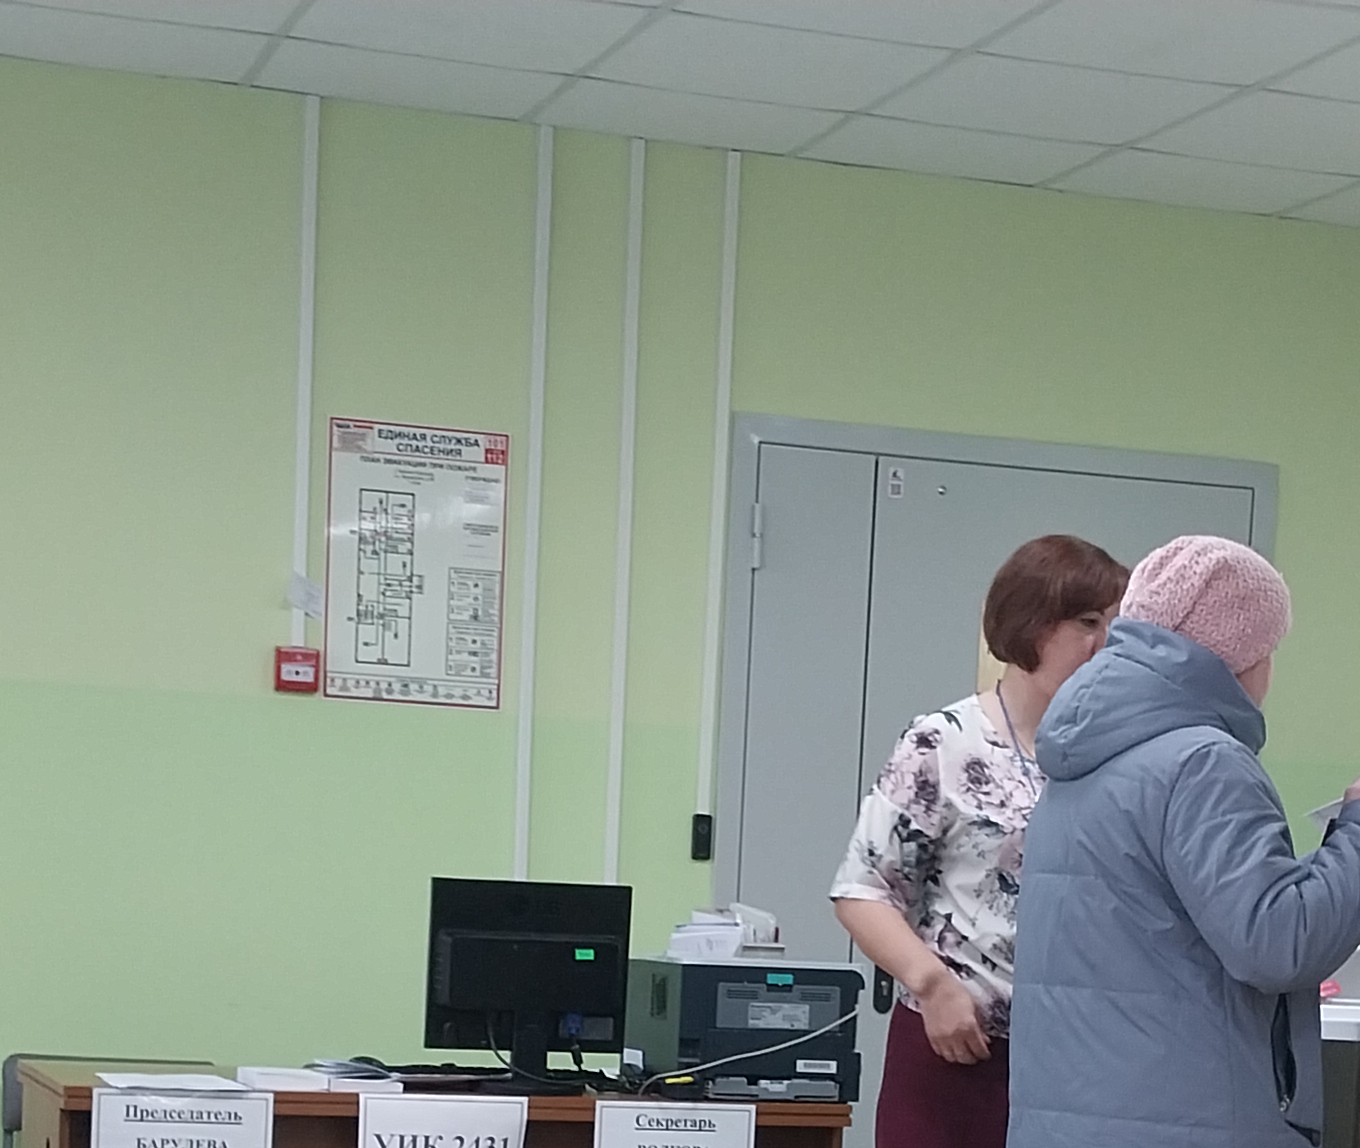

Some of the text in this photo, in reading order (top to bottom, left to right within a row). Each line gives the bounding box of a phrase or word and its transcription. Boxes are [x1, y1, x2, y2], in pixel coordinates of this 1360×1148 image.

[377, 429, 428, 444] ЕДИНАЯ
[430, 434, 480, 448] СЛУЖБА
[396, 443, 463, 458] СПАСЕНИЯ
[124, 1103, 243, 1124] Председатель
[634, 1113, 717, 1131] Секретарь
